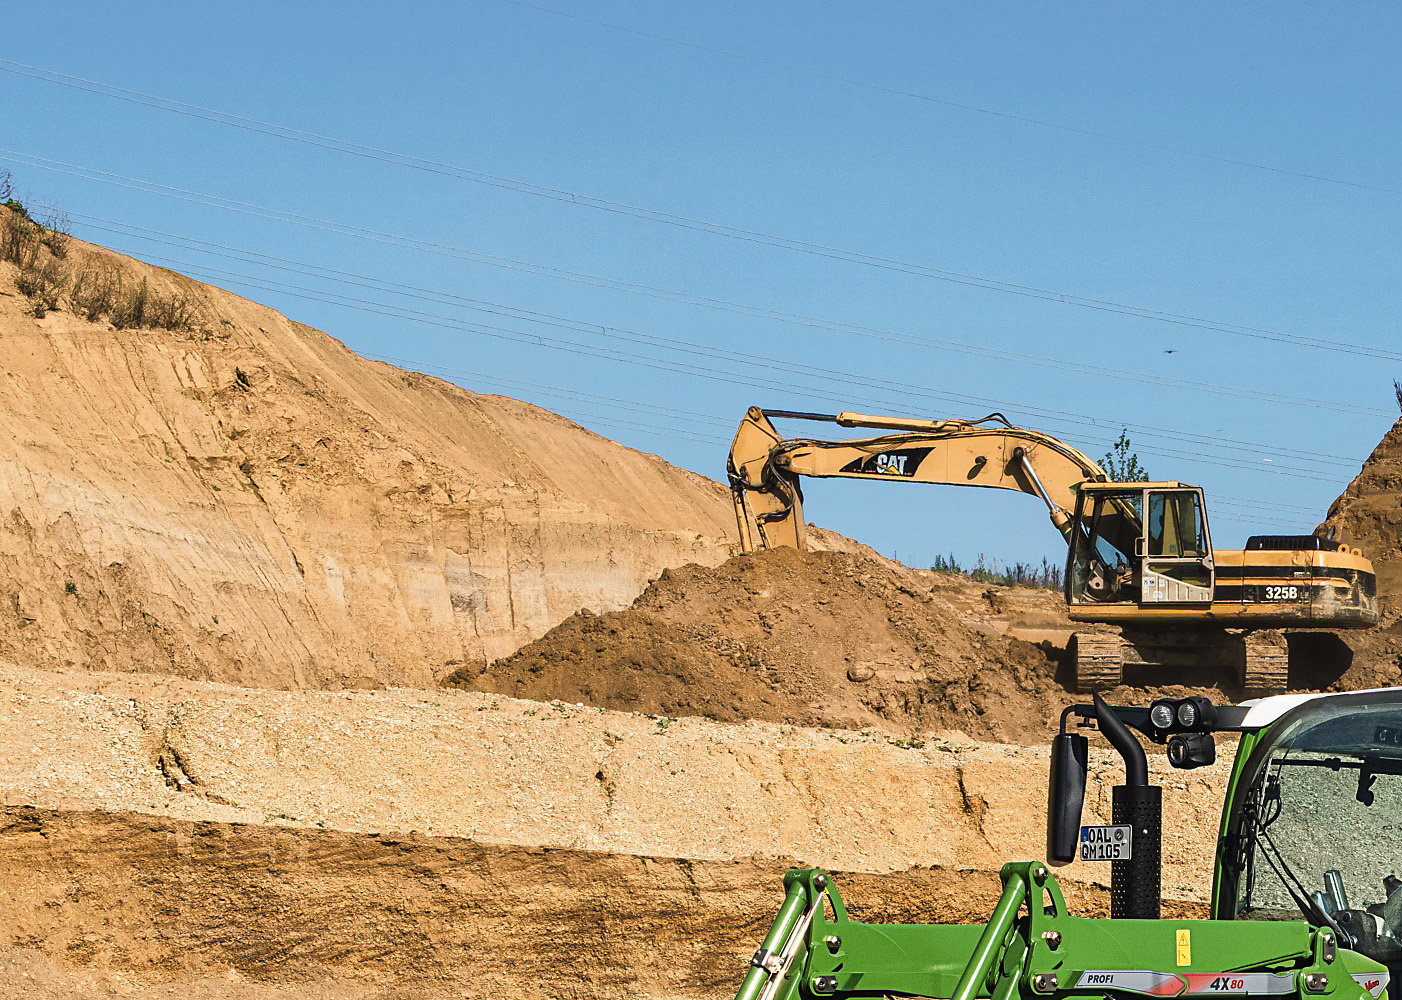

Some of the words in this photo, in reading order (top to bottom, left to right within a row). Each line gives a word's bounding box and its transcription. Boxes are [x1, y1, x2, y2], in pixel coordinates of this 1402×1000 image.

[877, 454, 907, 475] CAT
[1265, 586, 1298, 599] 325B
[1089, 829, 1112, 843] OAL
[1087, 974, 1114, 984] PROFI
